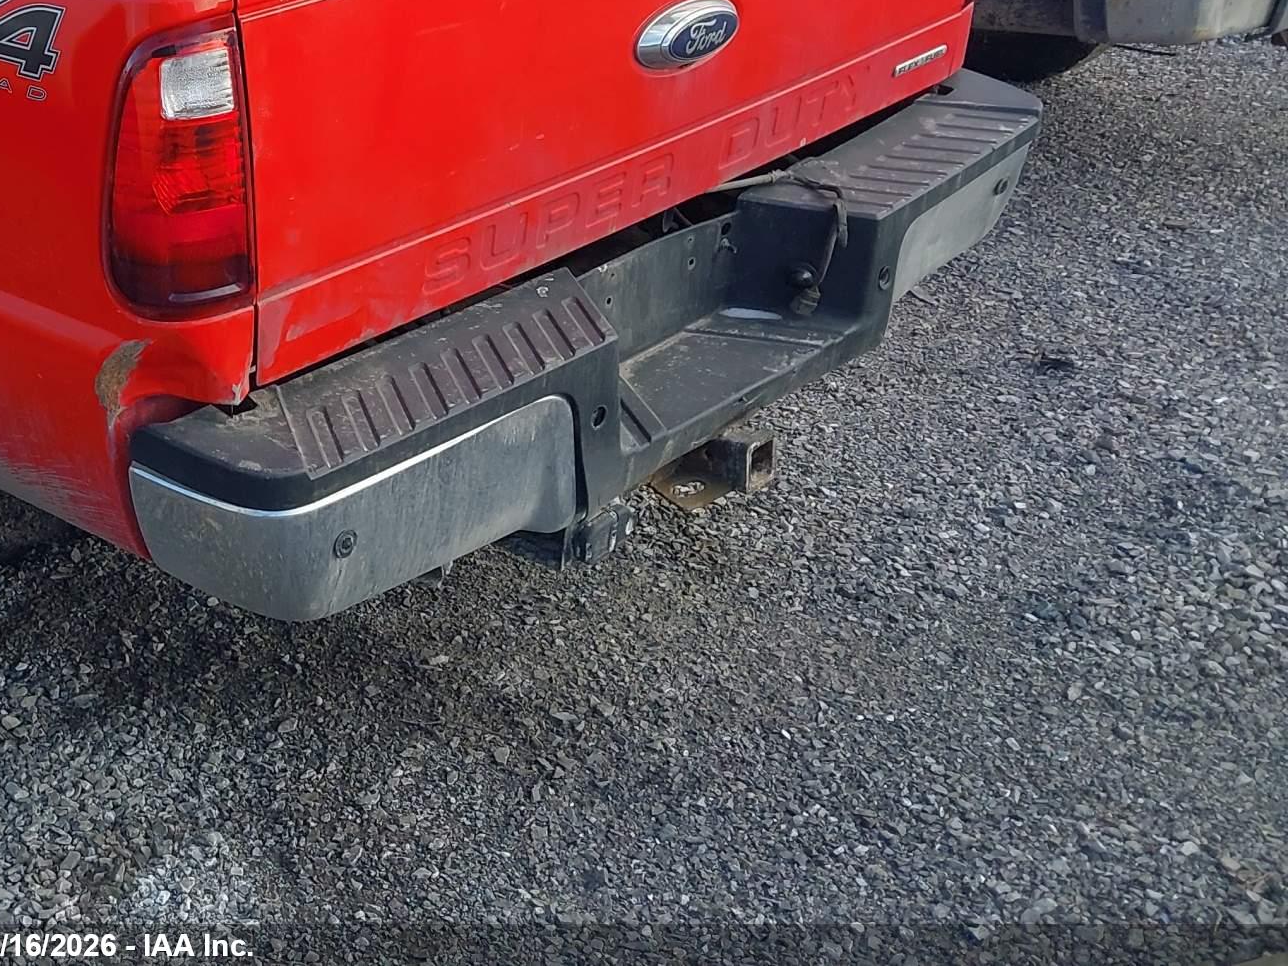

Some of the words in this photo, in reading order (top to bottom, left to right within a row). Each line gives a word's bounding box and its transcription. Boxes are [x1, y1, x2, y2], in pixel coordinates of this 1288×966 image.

[685, 18, 727, 55] Ford
[422, 152, 675, 296] SUPER
[718, 65, 870, 171] DUTY
